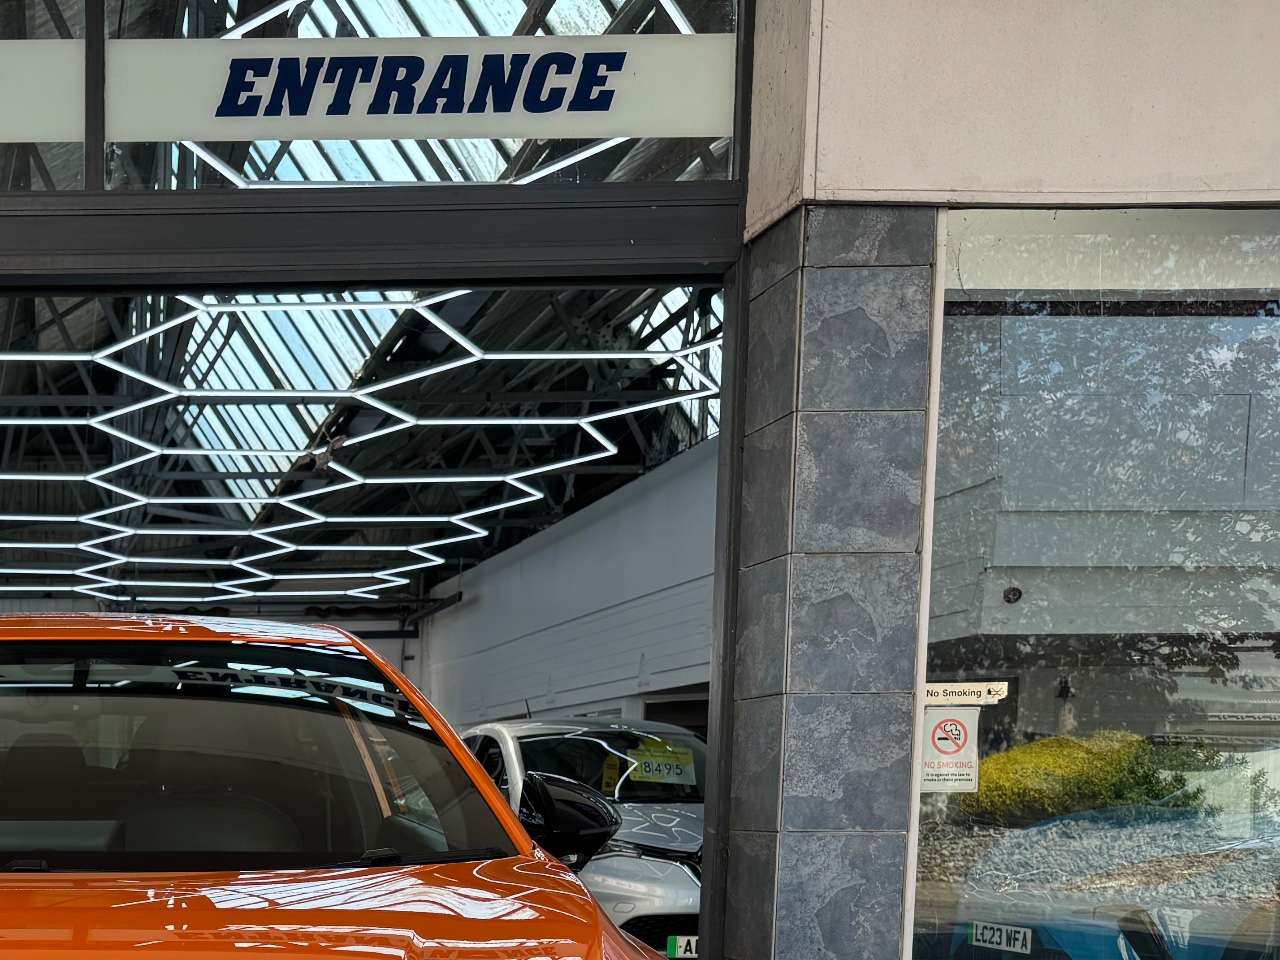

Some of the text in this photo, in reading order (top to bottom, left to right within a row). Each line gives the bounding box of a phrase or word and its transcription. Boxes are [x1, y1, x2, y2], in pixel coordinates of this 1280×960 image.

[215, 51, 627, 117] ENTRANCE
[926, 688, 982, 699] No Smoking
[923, 761, 936, 769] NO
[975, 923, 1002, 946] LC23
